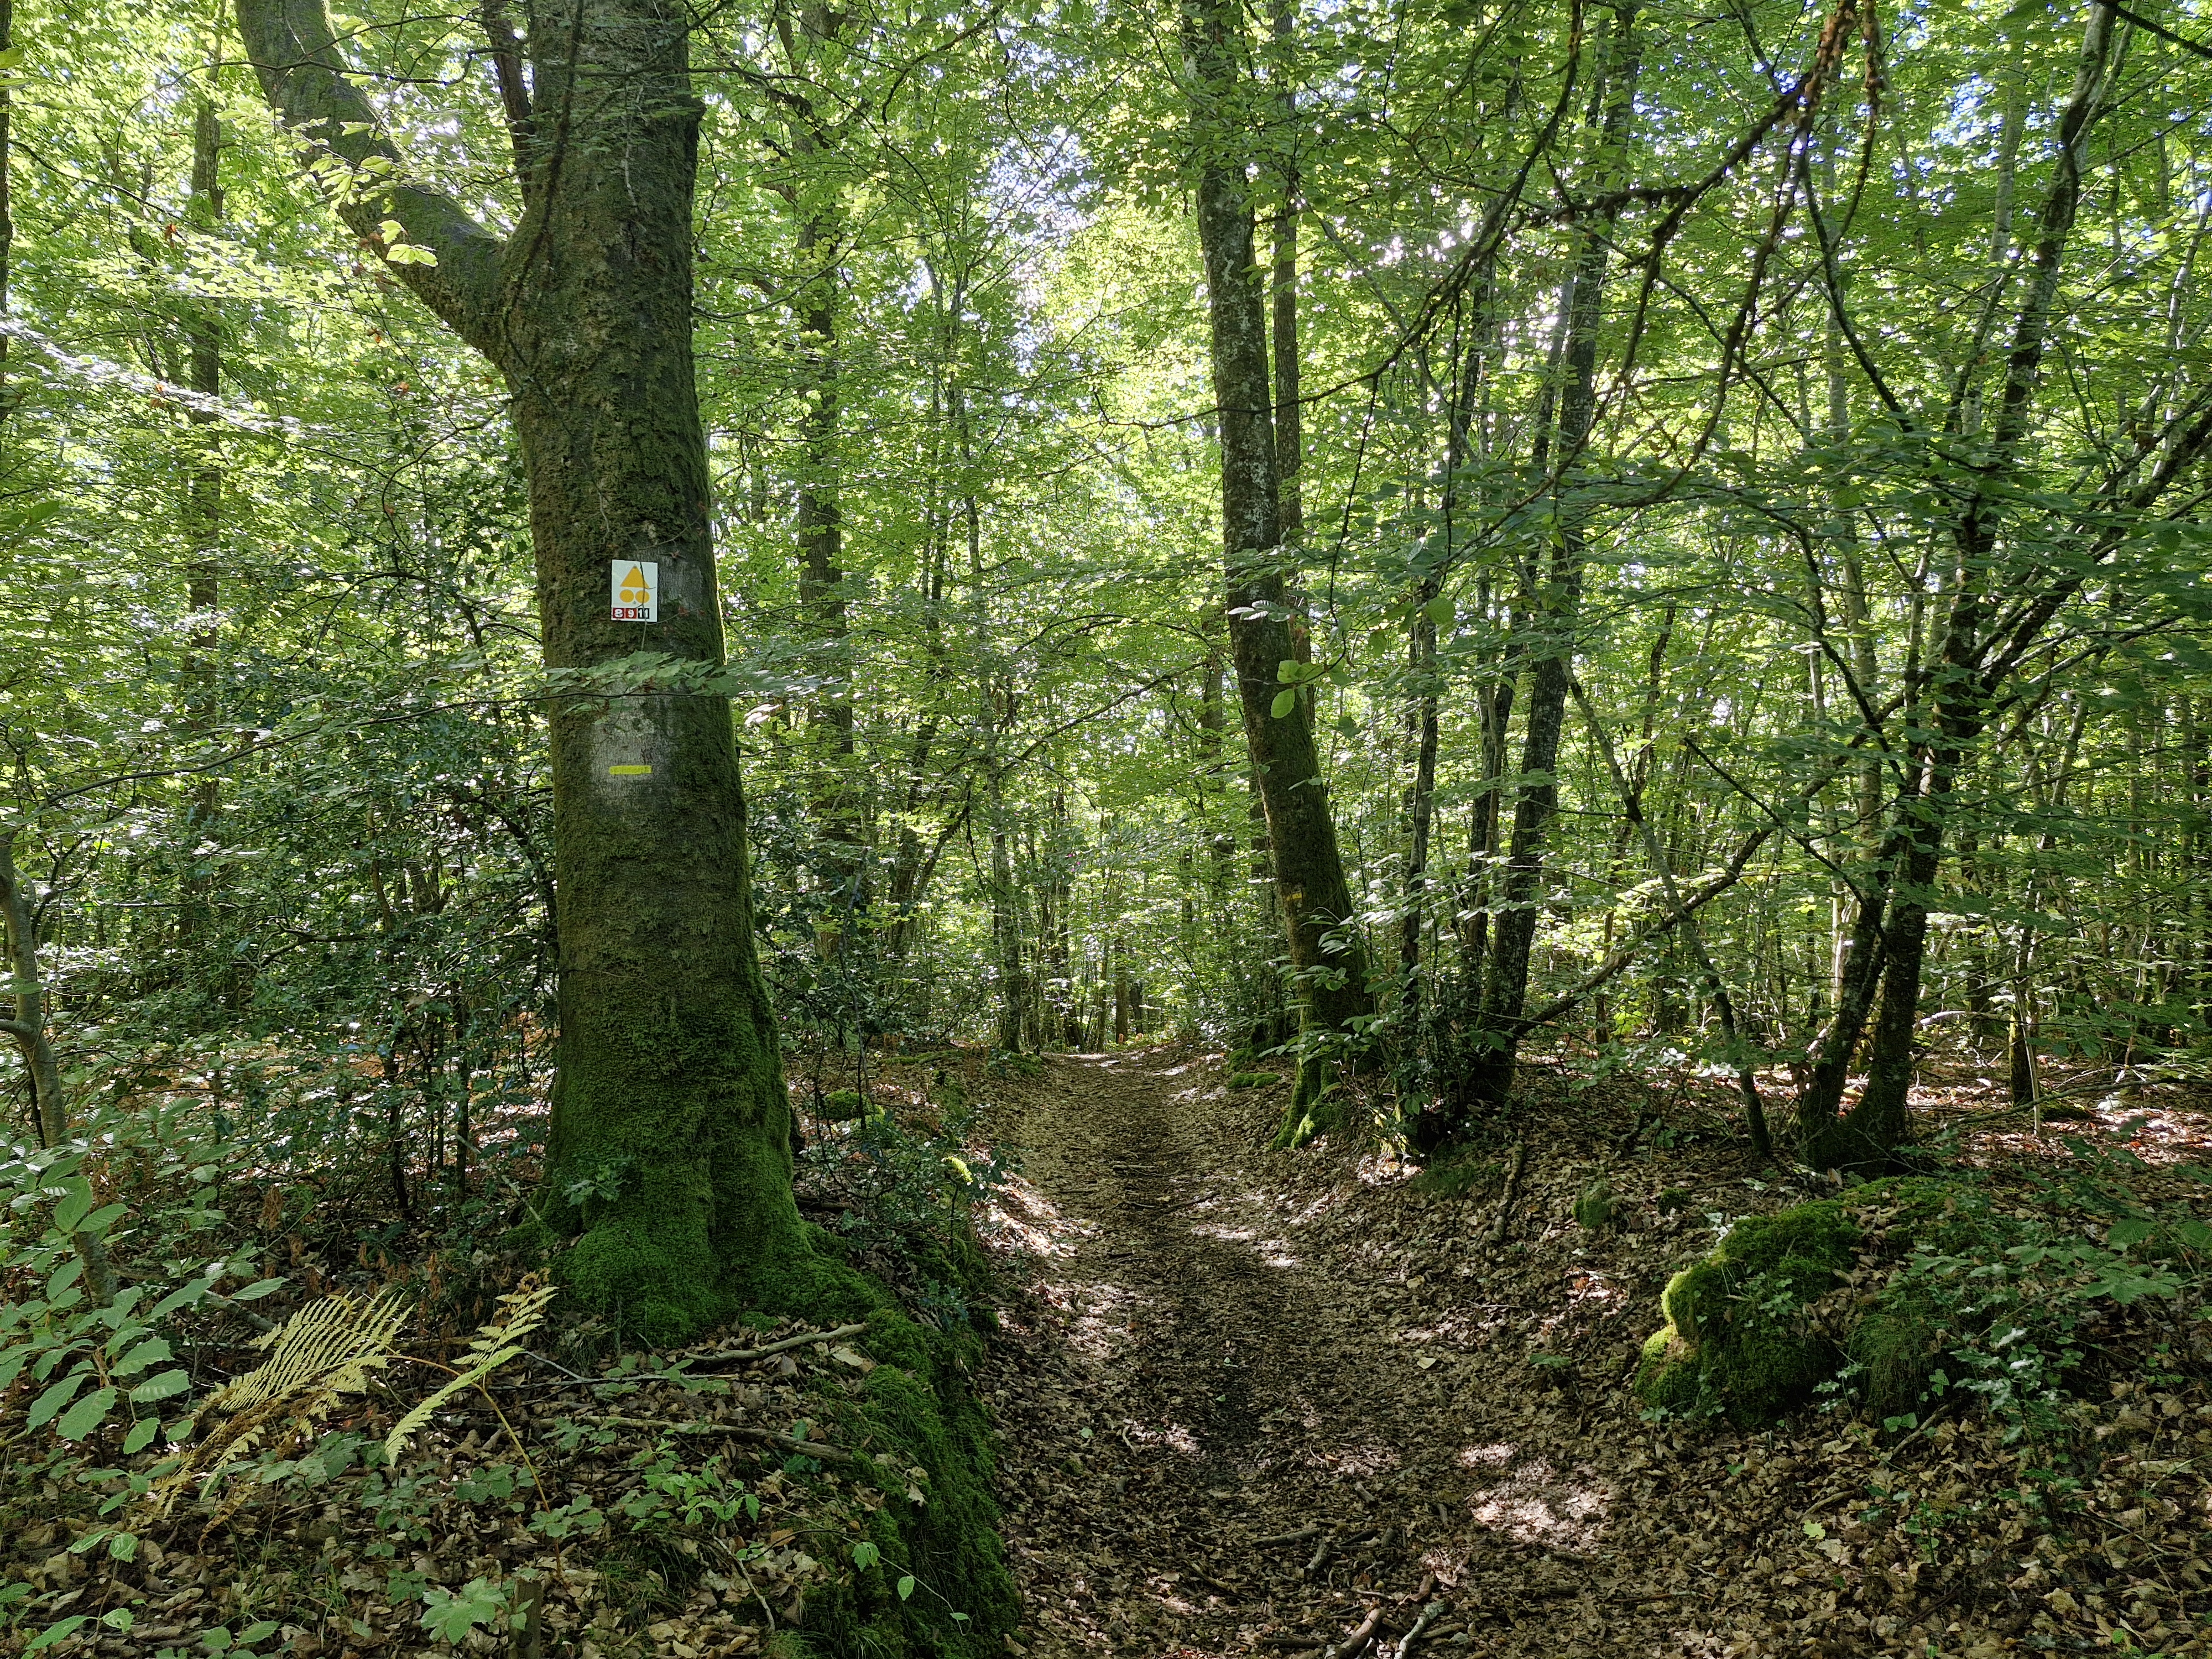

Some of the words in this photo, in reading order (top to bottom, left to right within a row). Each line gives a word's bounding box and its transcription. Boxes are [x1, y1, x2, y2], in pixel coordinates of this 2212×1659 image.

[614, 608, 623, 618] 8
[628, 609, 634, 618] 9
[638, 609, 648, 618] 11
